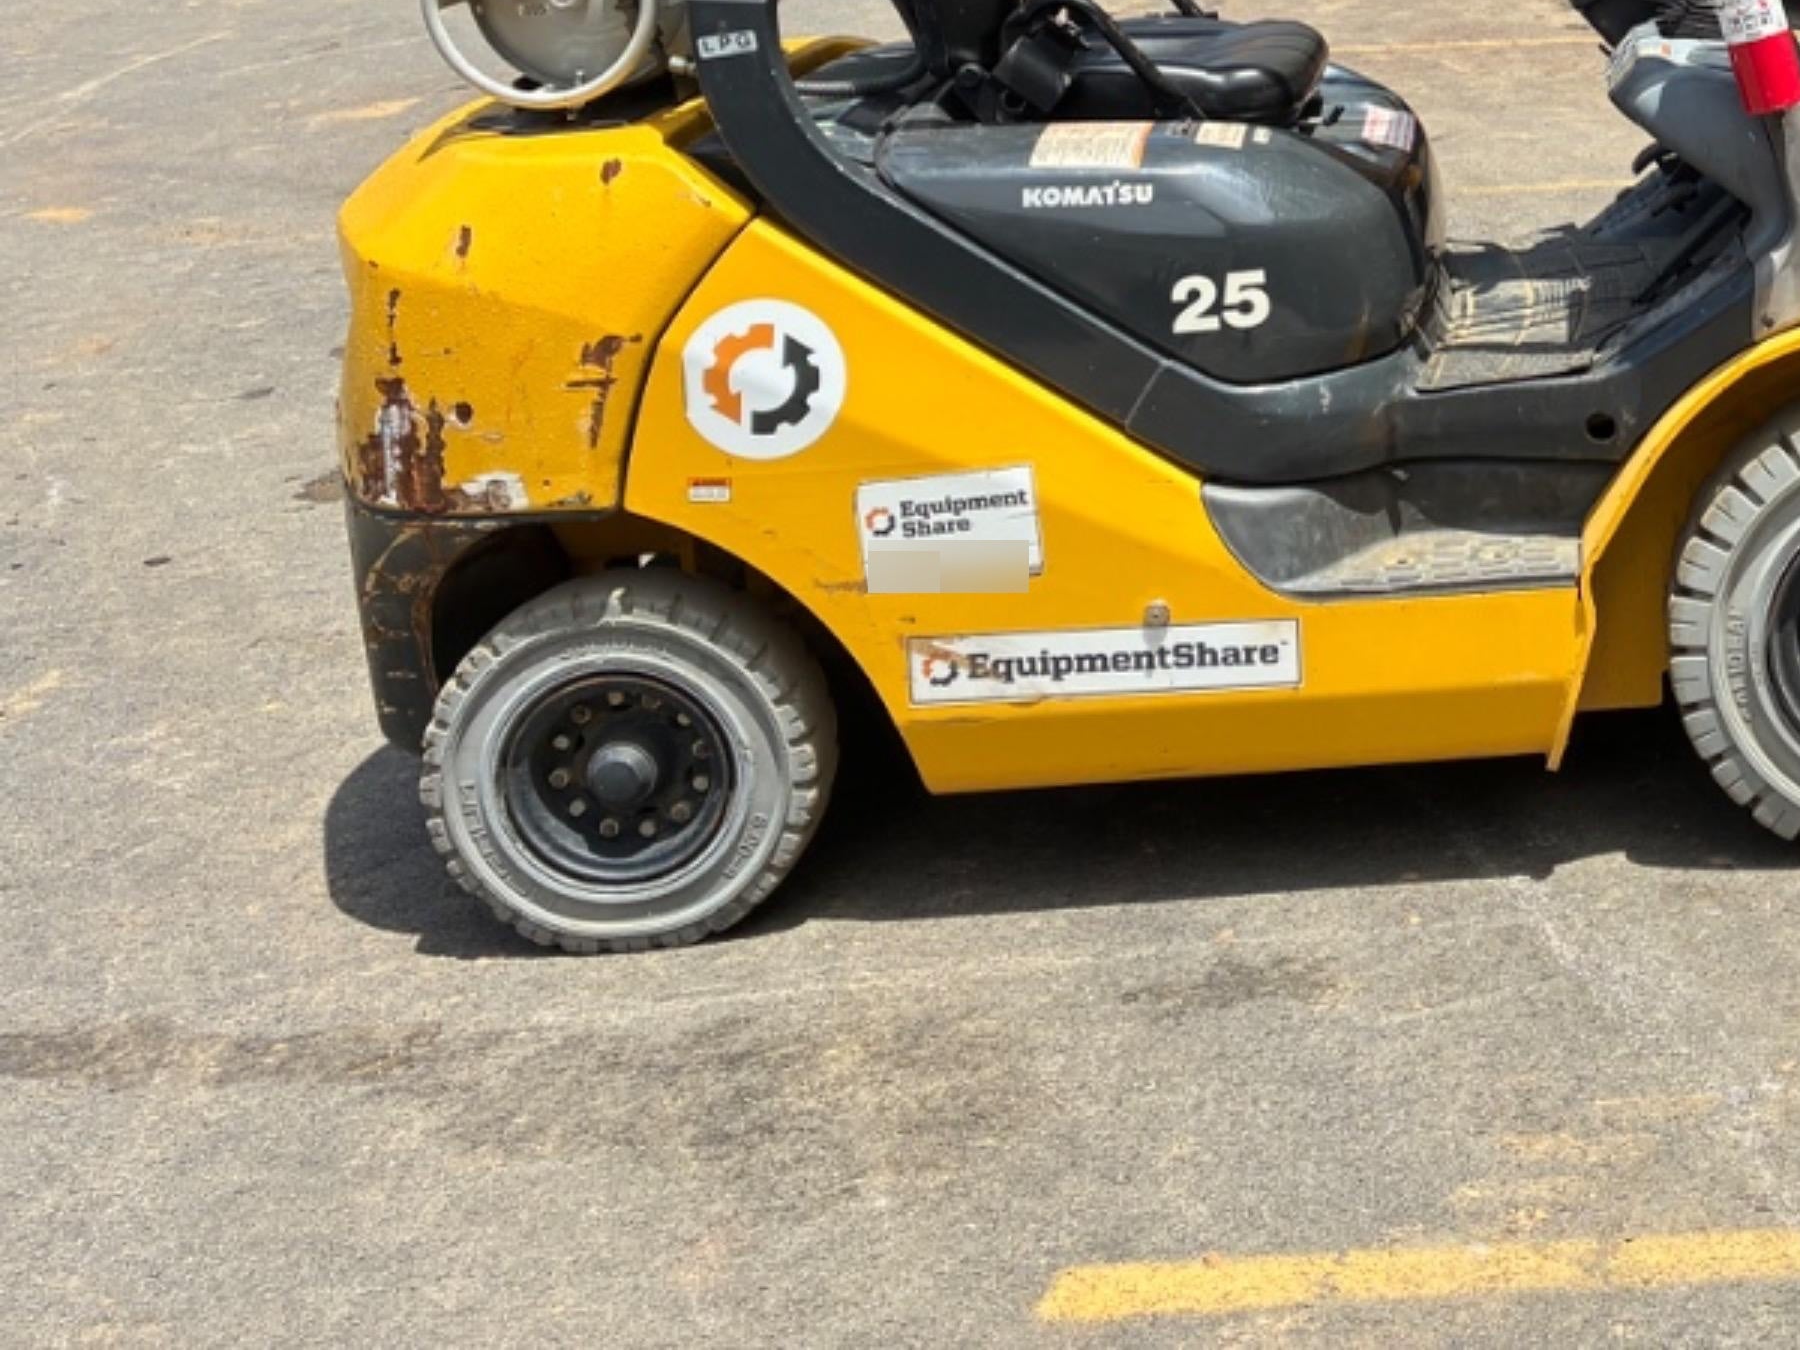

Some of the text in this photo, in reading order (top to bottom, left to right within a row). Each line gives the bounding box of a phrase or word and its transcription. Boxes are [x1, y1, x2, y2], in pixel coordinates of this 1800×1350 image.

[703, 33, 751, 52] LPG
[1022, 180, 1154, 208] KOMATSU
[1170, 268, 1271, 335] 25
[900, 488, 1029, 519] Equipment
[901, 516, 972, 538] Share
[966, 641, 1280, 684] EquipmentShare
